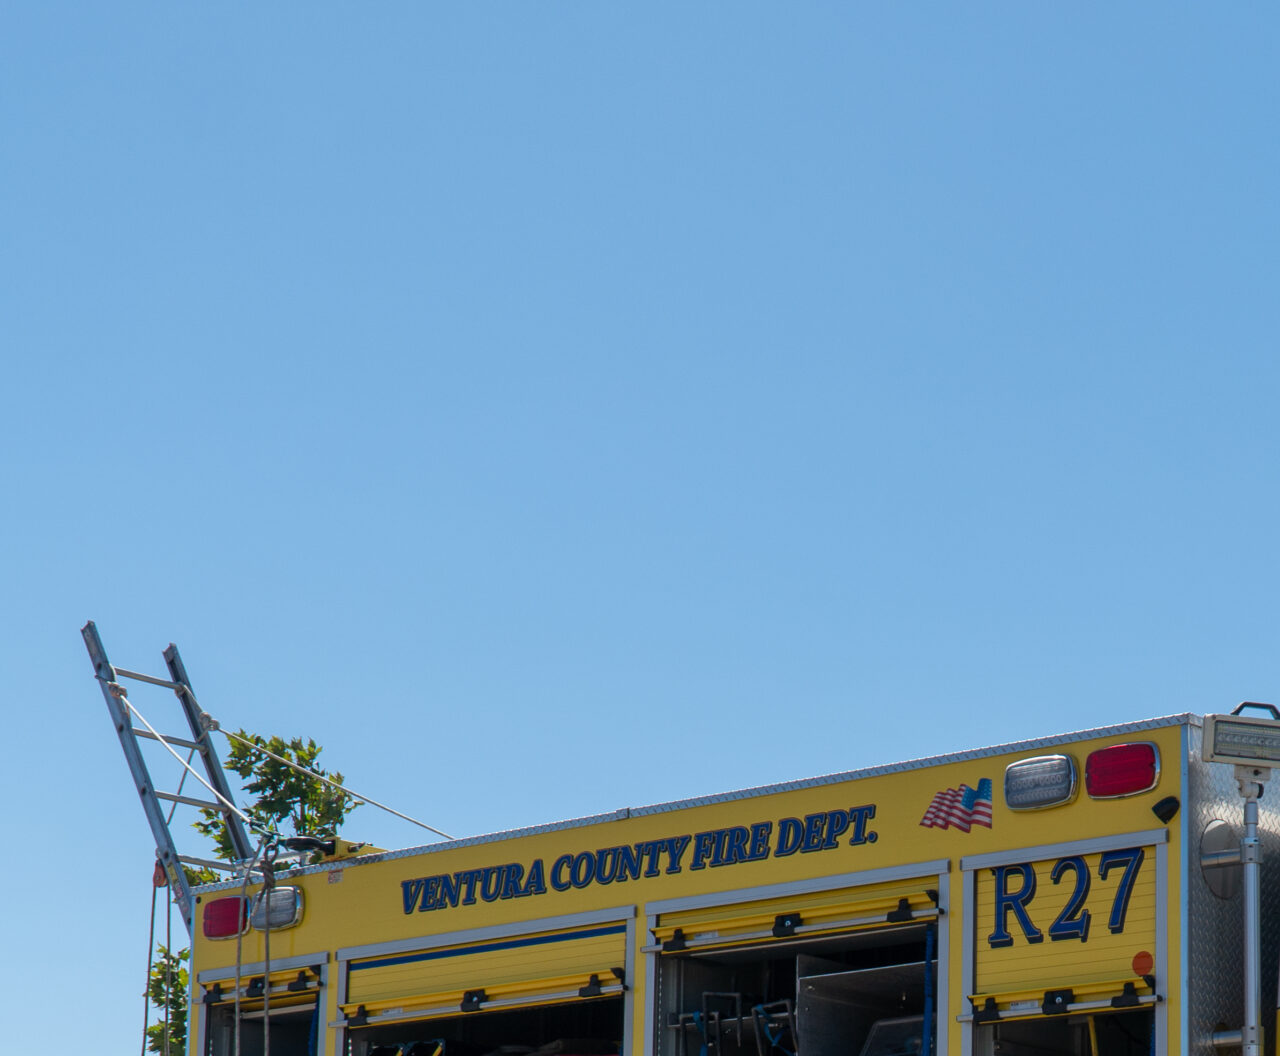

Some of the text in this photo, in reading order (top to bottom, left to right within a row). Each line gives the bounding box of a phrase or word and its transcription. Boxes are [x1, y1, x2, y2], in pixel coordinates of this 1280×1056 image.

[401, 804, 878, 914] VENTURA COUNTY FIRE DEPT.
[988, 848, 1144, 949] R27
